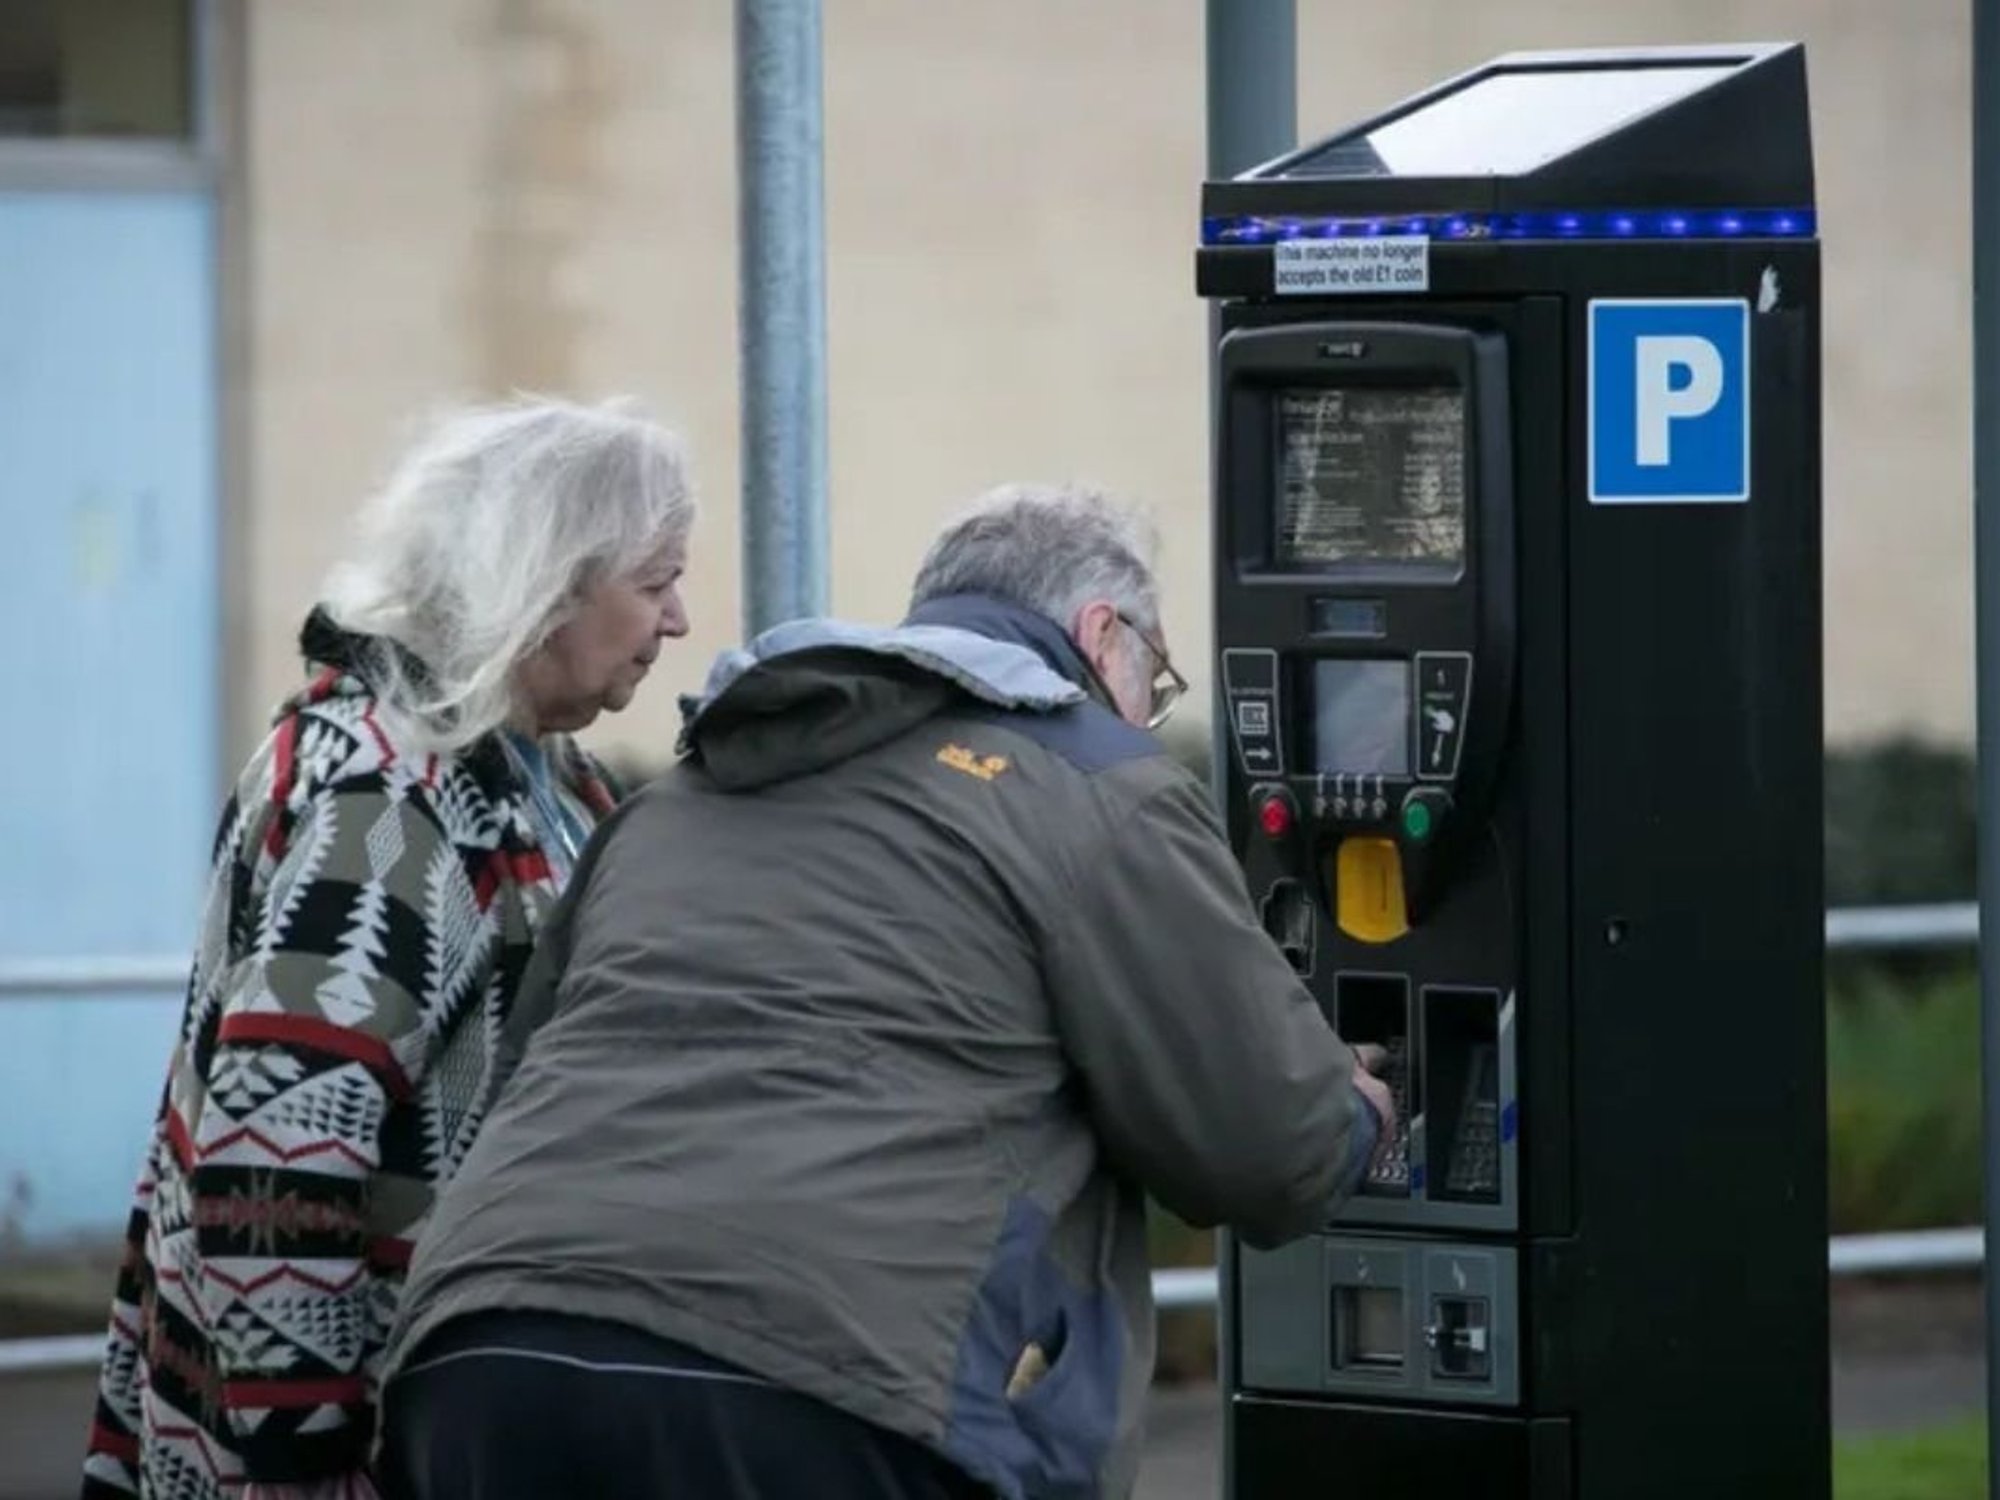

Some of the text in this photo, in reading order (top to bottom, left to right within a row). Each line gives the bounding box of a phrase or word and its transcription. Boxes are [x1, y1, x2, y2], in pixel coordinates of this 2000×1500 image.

[1305, 242, 1359, 260] machine
[1362, 245, 1379, 259] no
[1383, 240, 1424, 262] longer
[1278, 267, 1326, 288] accepts
[1329, 265, 1349, 283] the
[1352, 264, 1374, 283] old
[1394, 263, 1423, 282] coin
[1636, 335, 1723, 466] P
